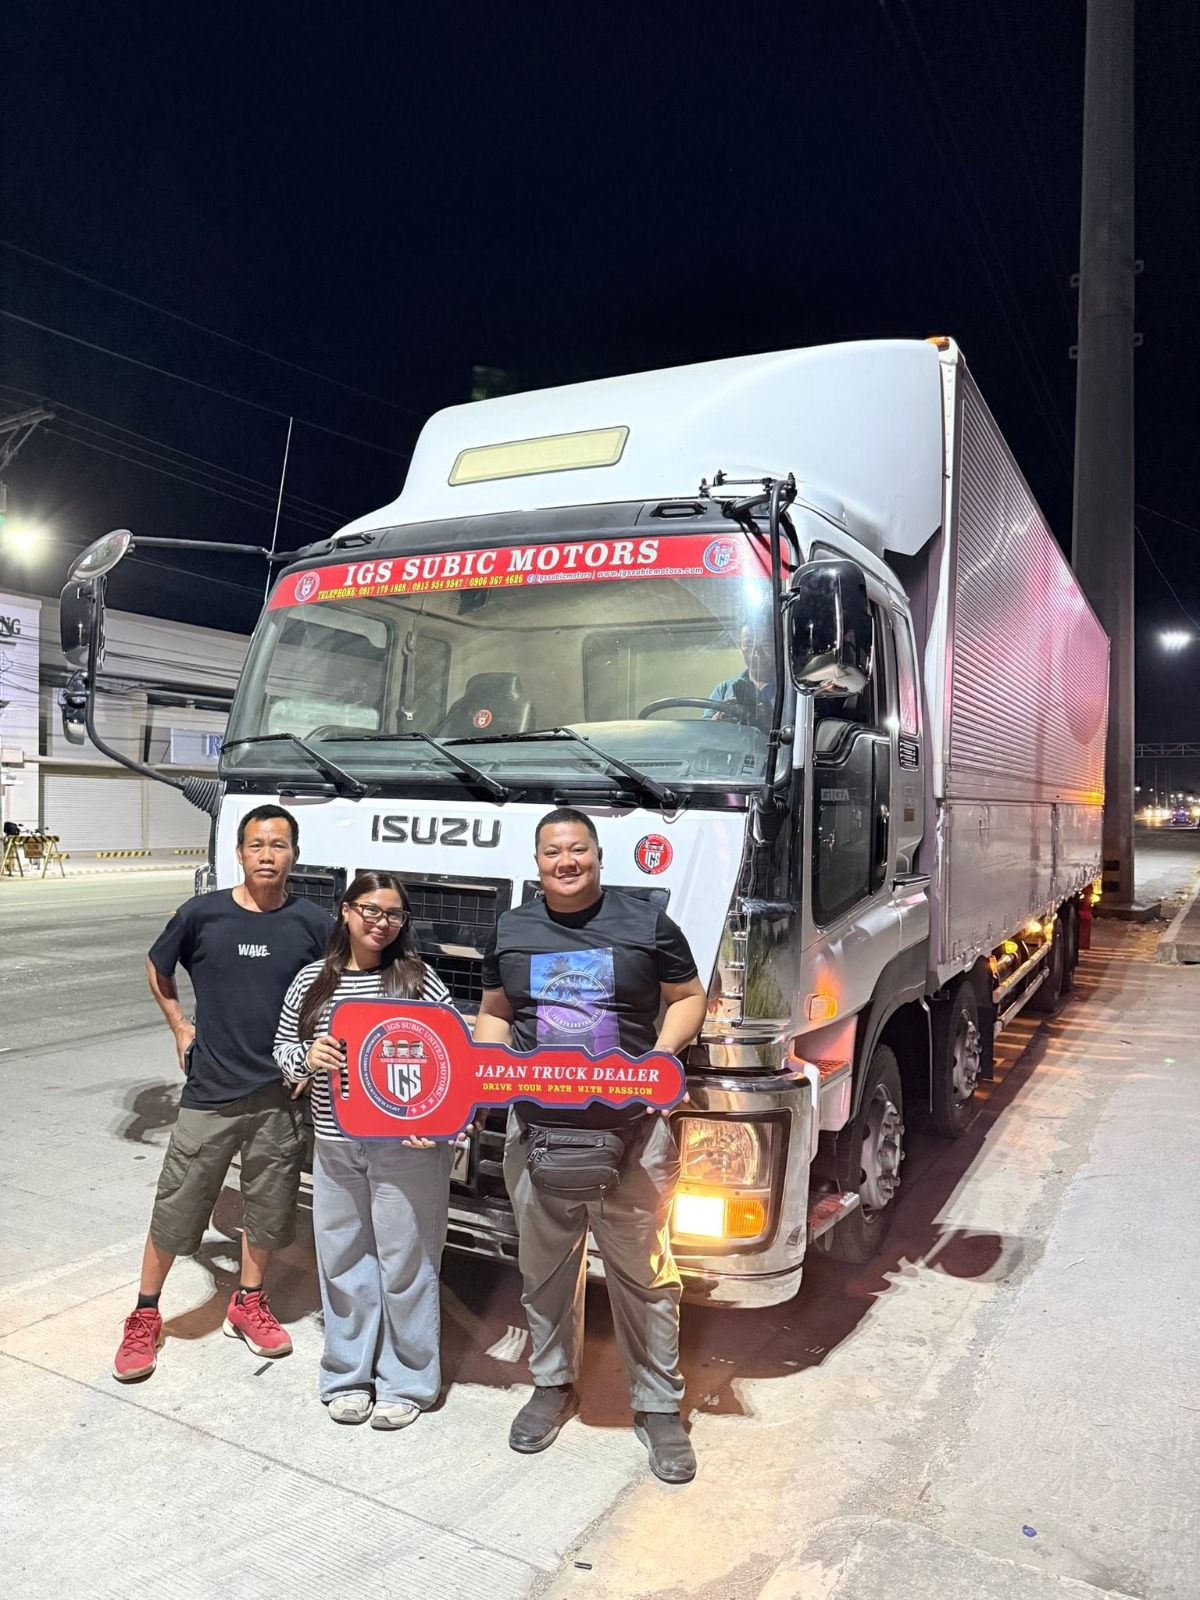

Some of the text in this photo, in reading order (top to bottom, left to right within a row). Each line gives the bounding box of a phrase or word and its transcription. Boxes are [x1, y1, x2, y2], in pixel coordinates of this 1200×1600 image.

[344, 540, 659, 586] IGS SUBIC MOTORS
[412, 581, 429, 591] 0915
[469, 577, 488, 587] 0906
[505, 574, 523, 584] 4626
[821, 788, 850, 801] GIGA
[372, 814, 502, 848] ISUZU
[387, 1021, 447, 1096] IGS SUBIC UNITED MOTORS
[387, 1063, 421, 1104] IGS
[475, 1064, 660, 1083] JAPAN TRUCK DEALER
[482, 1082, 653, 1095] DRIVE YOUR PATH WITH PASSION
